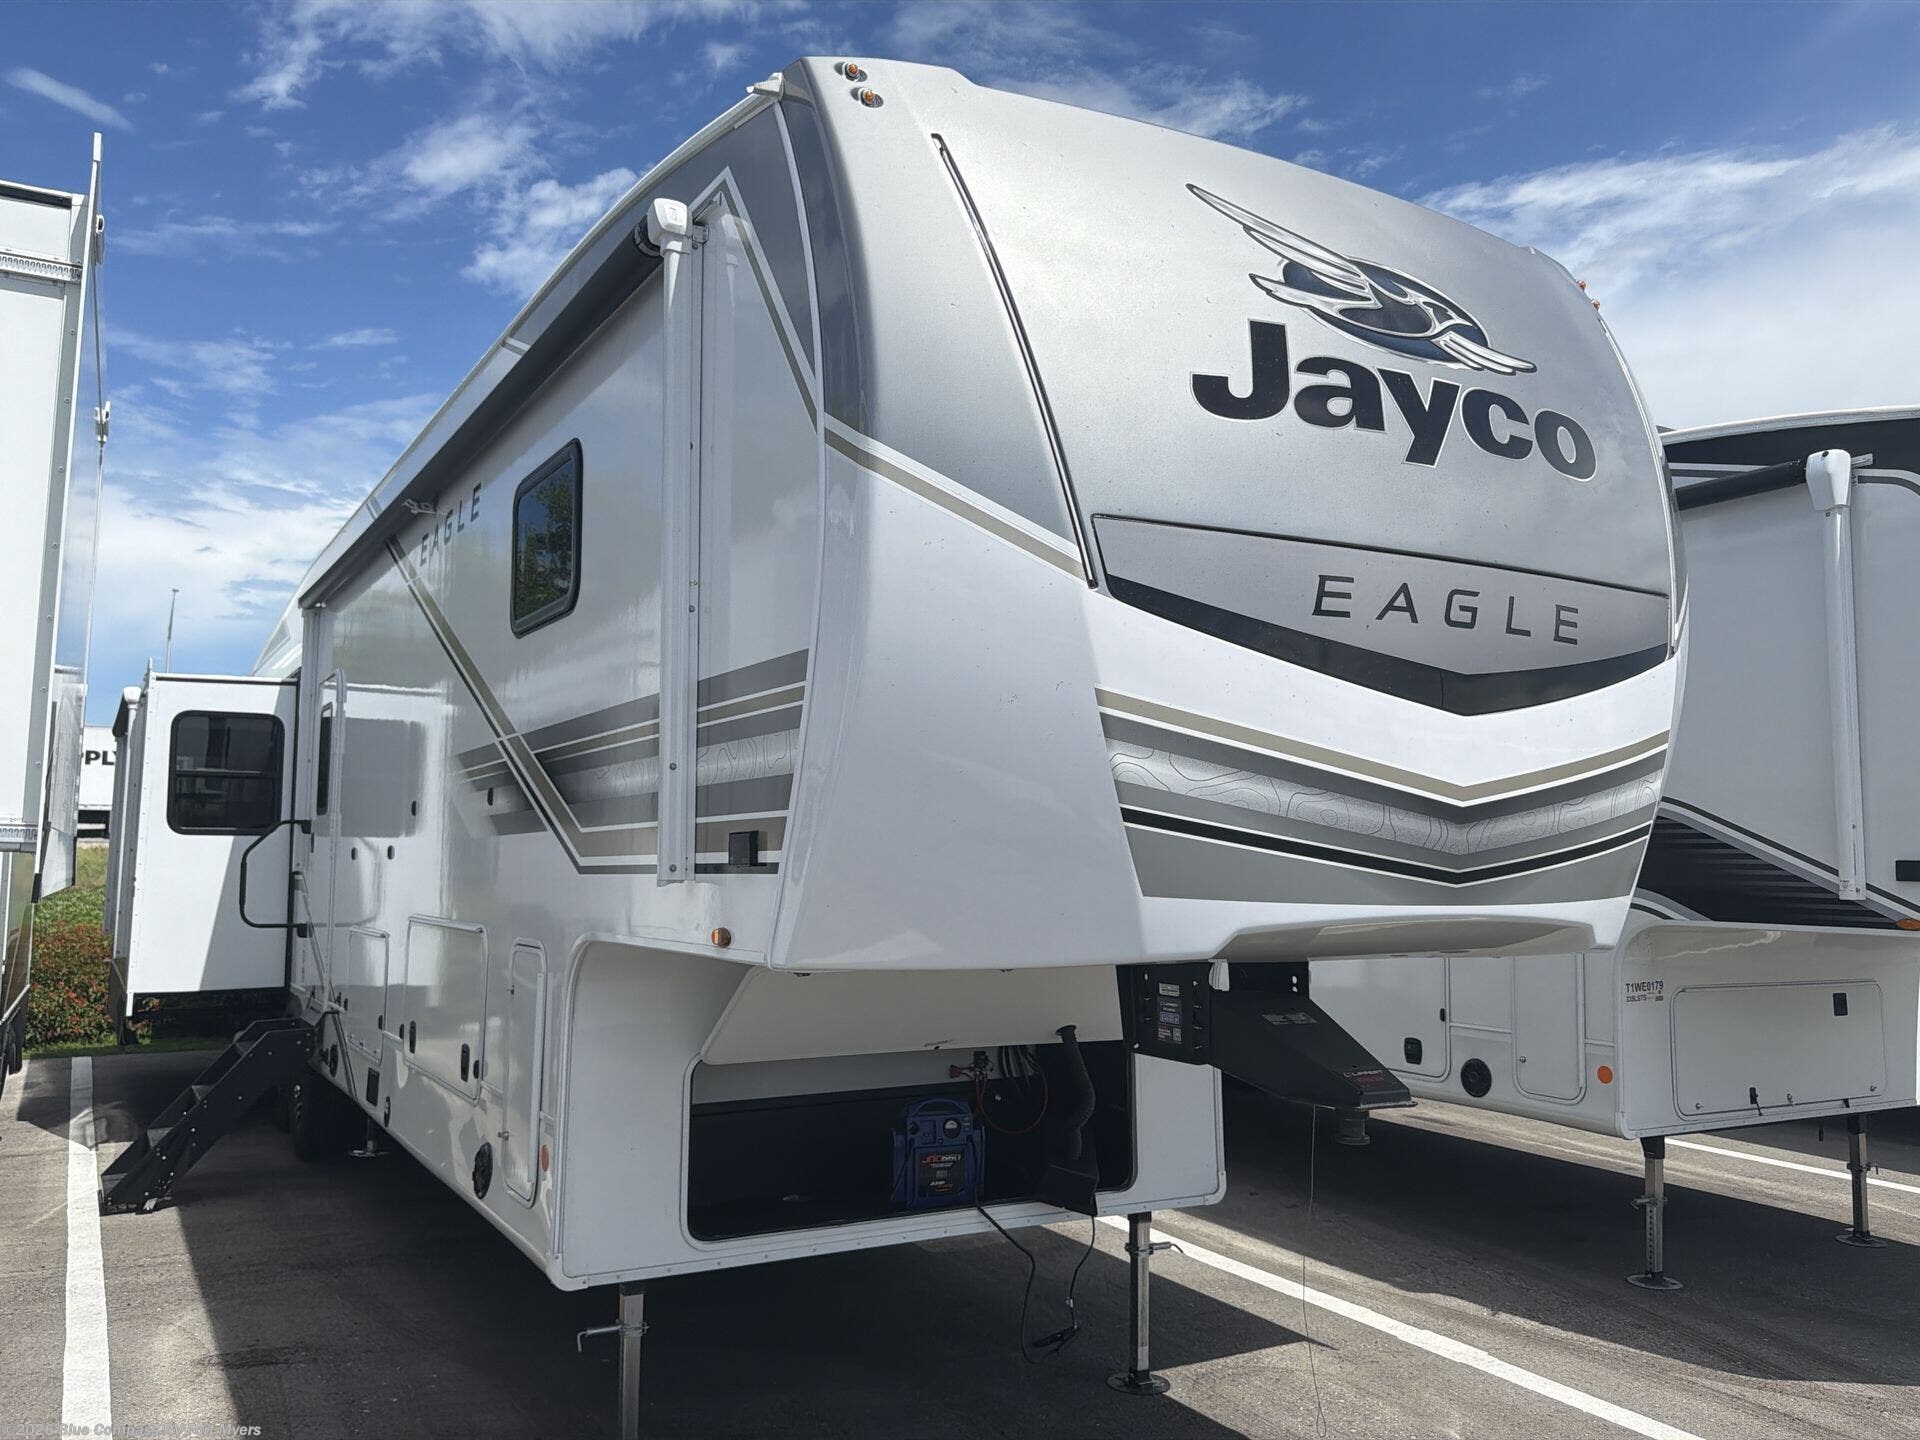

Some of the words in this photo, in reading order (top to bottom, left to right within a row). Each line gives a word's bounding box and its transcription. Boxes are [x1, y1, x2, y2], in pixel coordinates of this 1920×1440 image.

[1190, 320, 1597, 481] Jayco
[420, 482, 482, 567] EAGLE
[1311, 574, 1579, 646] EAGLE
[1626, 980, 1663, 993] T1WE0179
